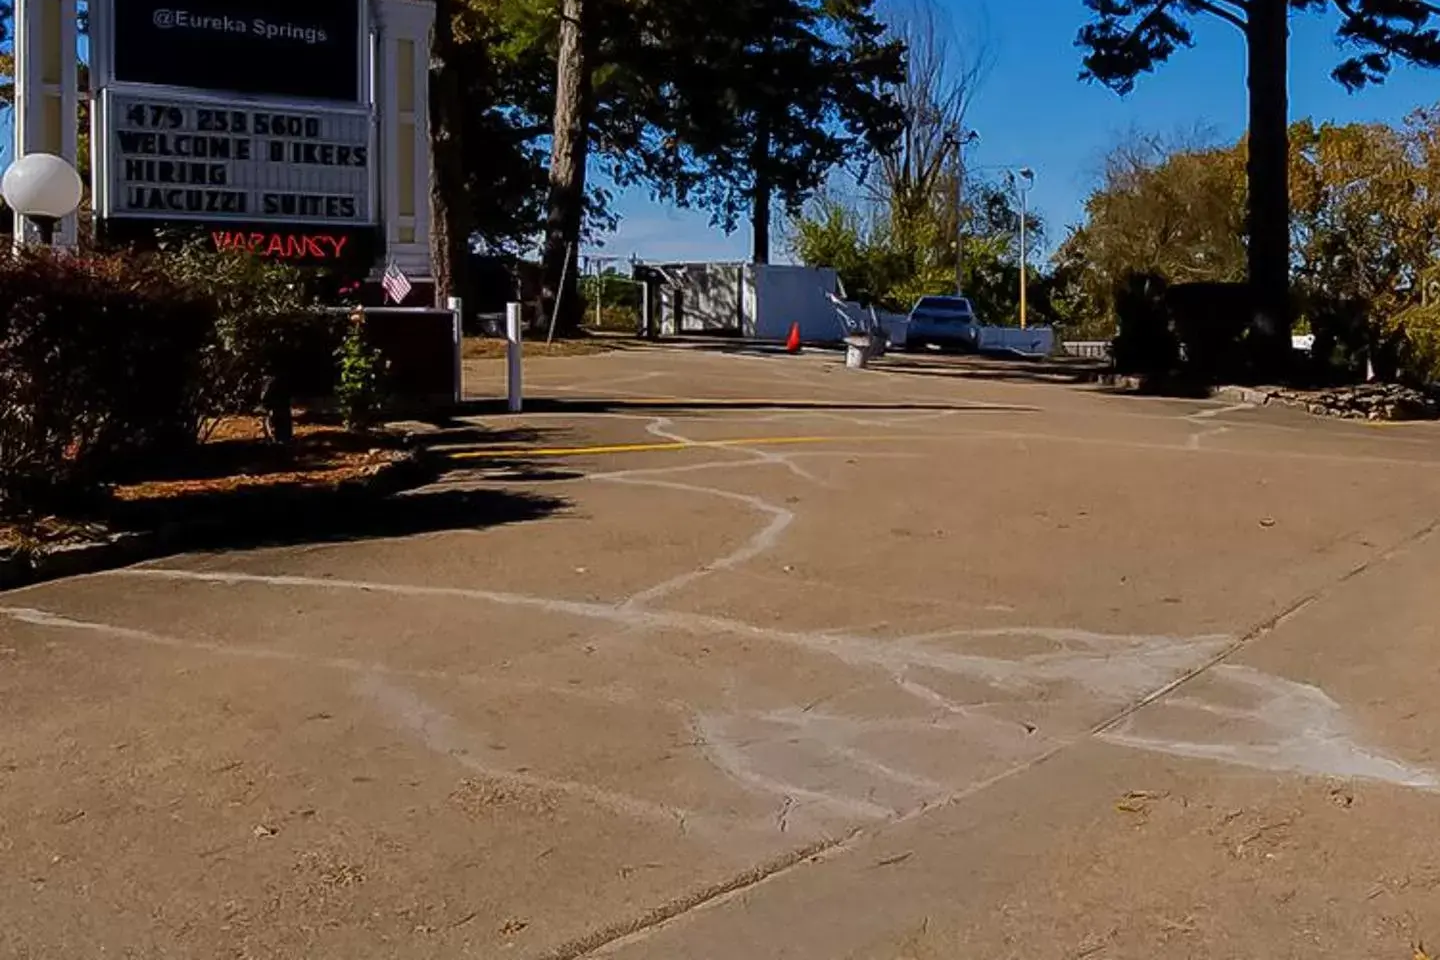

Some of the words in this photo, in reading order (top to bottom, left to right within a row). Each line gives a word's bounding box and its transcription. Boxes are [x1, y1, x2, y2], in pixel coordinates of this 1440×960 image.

[152, 8, 247, 35] @Eureka
[252, 18, 328, 45] Springs
[125, 103, 184, 129] 479
[117, 130, 250, 161] WELCOME
[125, 159, 227, 186] HIRING
[127, 188, 247, 213] JACUZZI
[262, 193, 356, 218] SUITES
